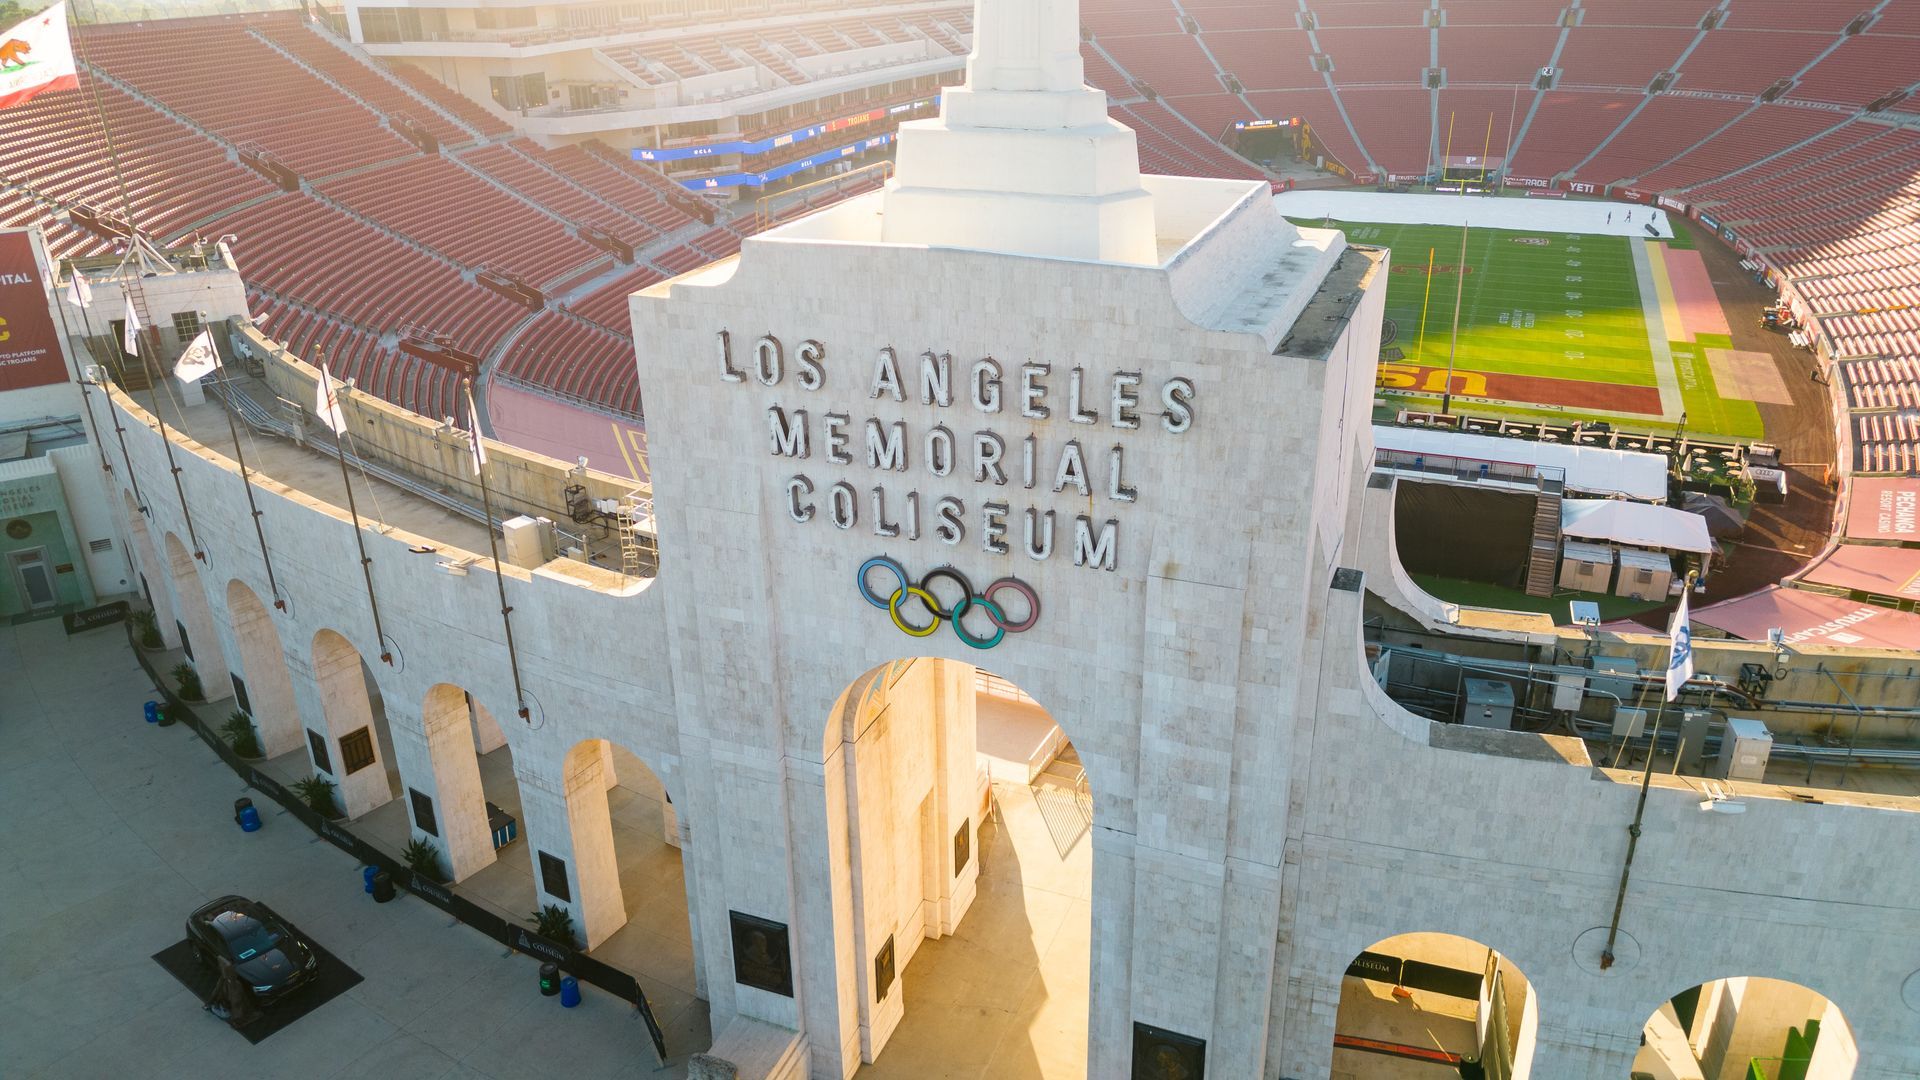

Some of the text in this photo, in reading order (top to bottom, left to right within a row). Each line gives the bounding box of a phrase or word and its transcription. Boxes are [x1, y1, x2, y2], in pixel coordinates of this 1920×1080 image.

[1569, 182, 1594, 193] YETI
[0, 272, 33, 286] ITAL
[12, 348, 46, 359] PLATFORM
[716, 328, 1196, 434] LOS ANGELES
[767, 403, 1138, 502] MEMORIAL
[786, 473, 1119, 572] COLISEUM
[1878, 490, 1893, 533] RESORT CASINO
[1895, 491, 1916, 534] PECHANGA
[532, 943, 565, 961] COLISEUM
[1351, 959, 1390, 973] OLISEUM
